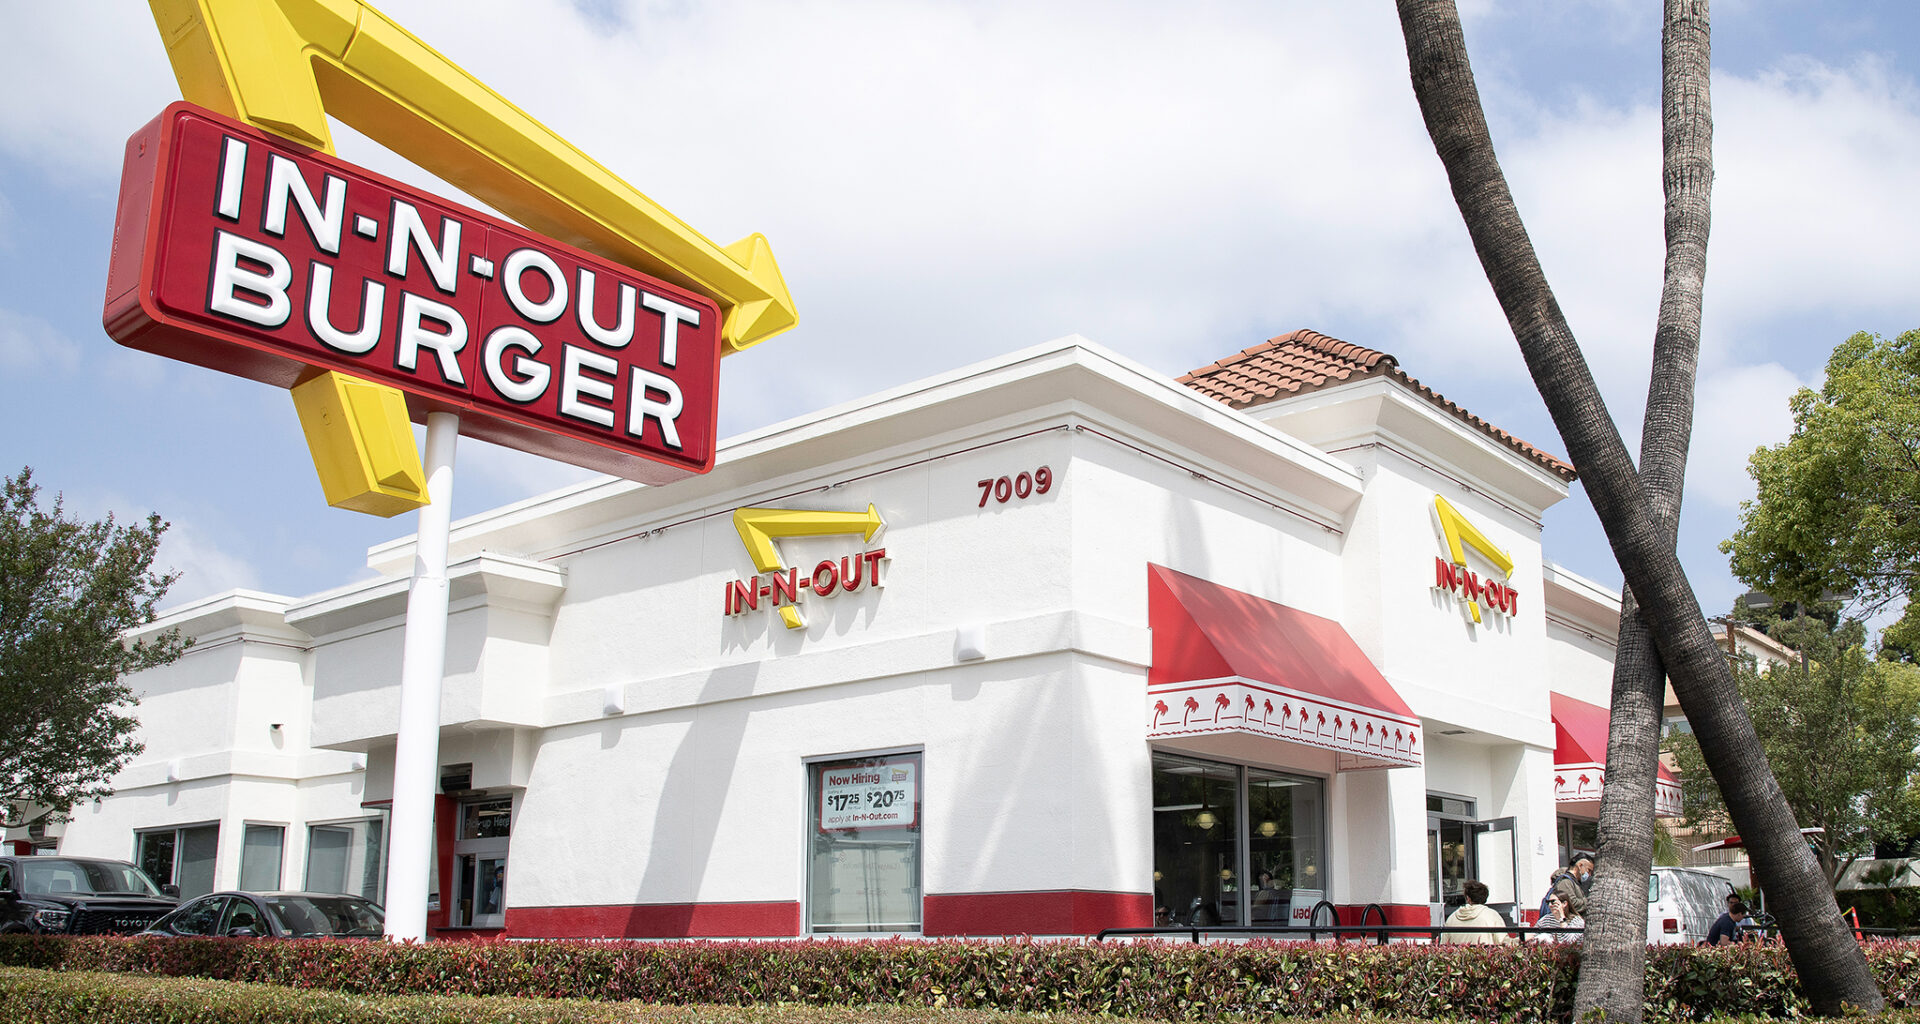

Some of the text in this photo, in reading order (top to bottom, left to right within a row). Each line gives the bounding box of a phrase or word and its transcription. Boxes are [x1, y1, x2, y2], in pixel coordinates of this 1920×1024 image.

[215, 135, 701, 367] IN-N-OUT
[209, 229, 685, 450] BURGER
[978, 465, 1053, 508] 7009
[725, 548, 886, 618] IN-N-OUT
[1435, 556, 1519, 618] IN-N-OUT
[829, 776, 850, 786] Now
[852, 773, 880, 784] Hiring
[828, 816, 844, 825] apply
[852, 813, 898, 821] In-N-Out.com
[1293, 906, 1311, 919] pen
